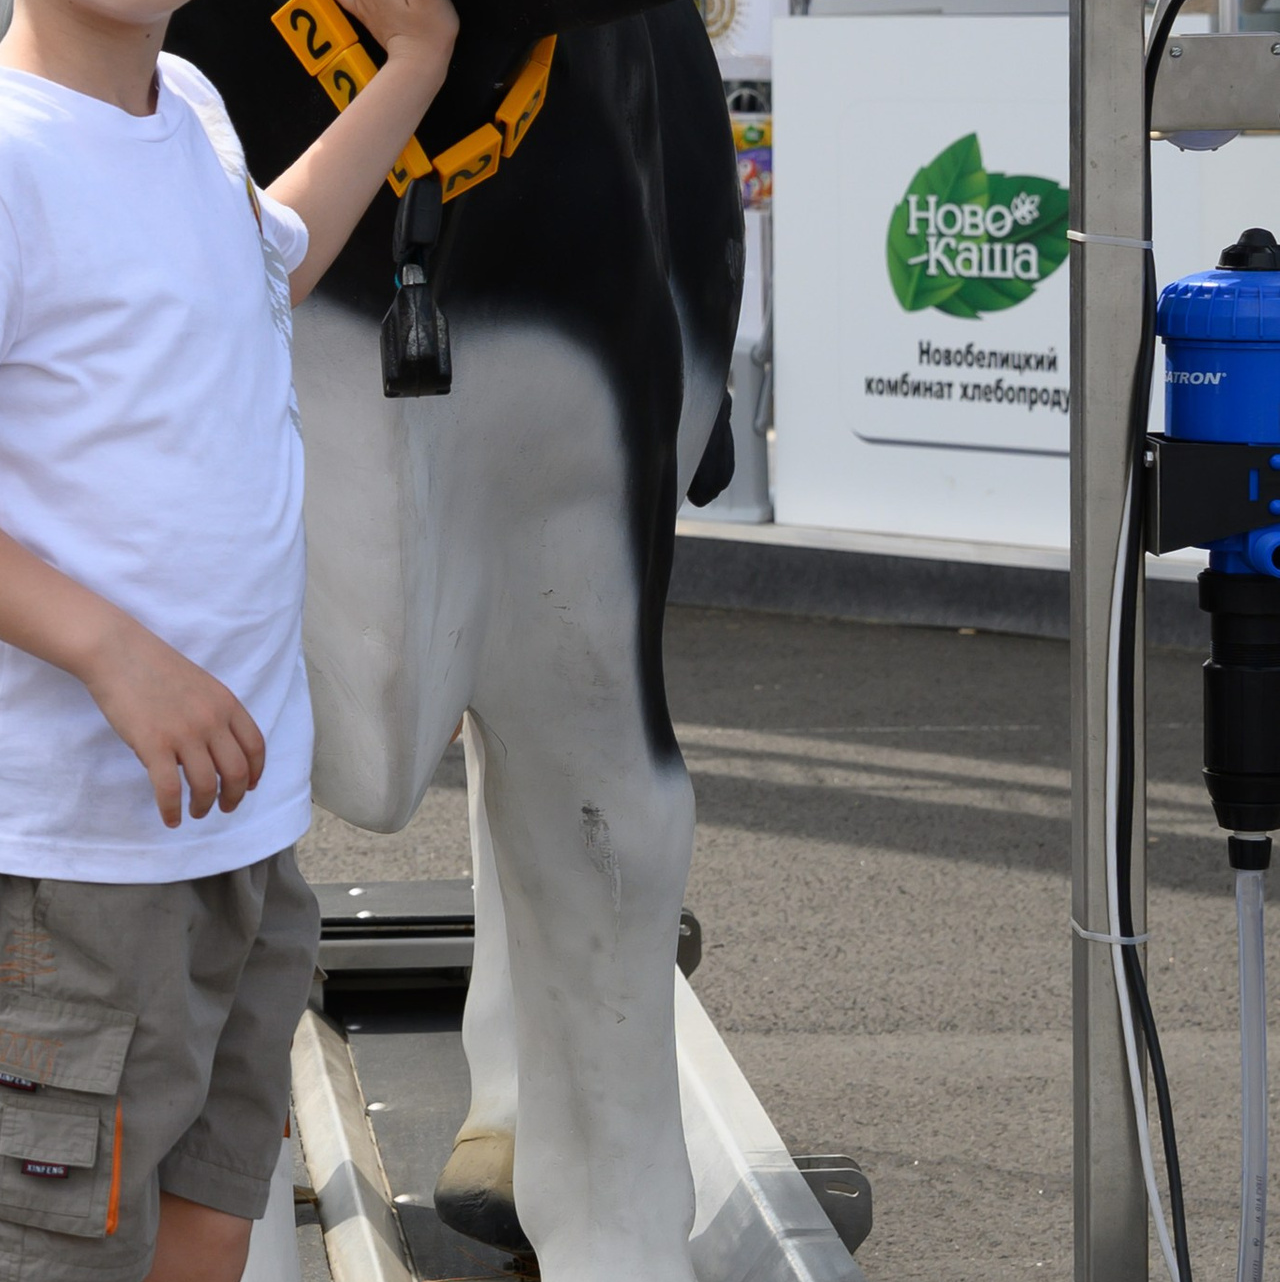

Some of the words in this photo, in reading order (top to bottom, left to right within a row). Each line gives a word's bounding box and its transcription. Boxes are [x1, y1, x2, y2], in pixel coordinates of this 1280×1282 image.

[290, 8, 332, 60] 2
[908, 235, 1040, 280] Каша
[918, 340, 1059, 374] Новобелицкий
[865, 373, 953, 401] комбинат
